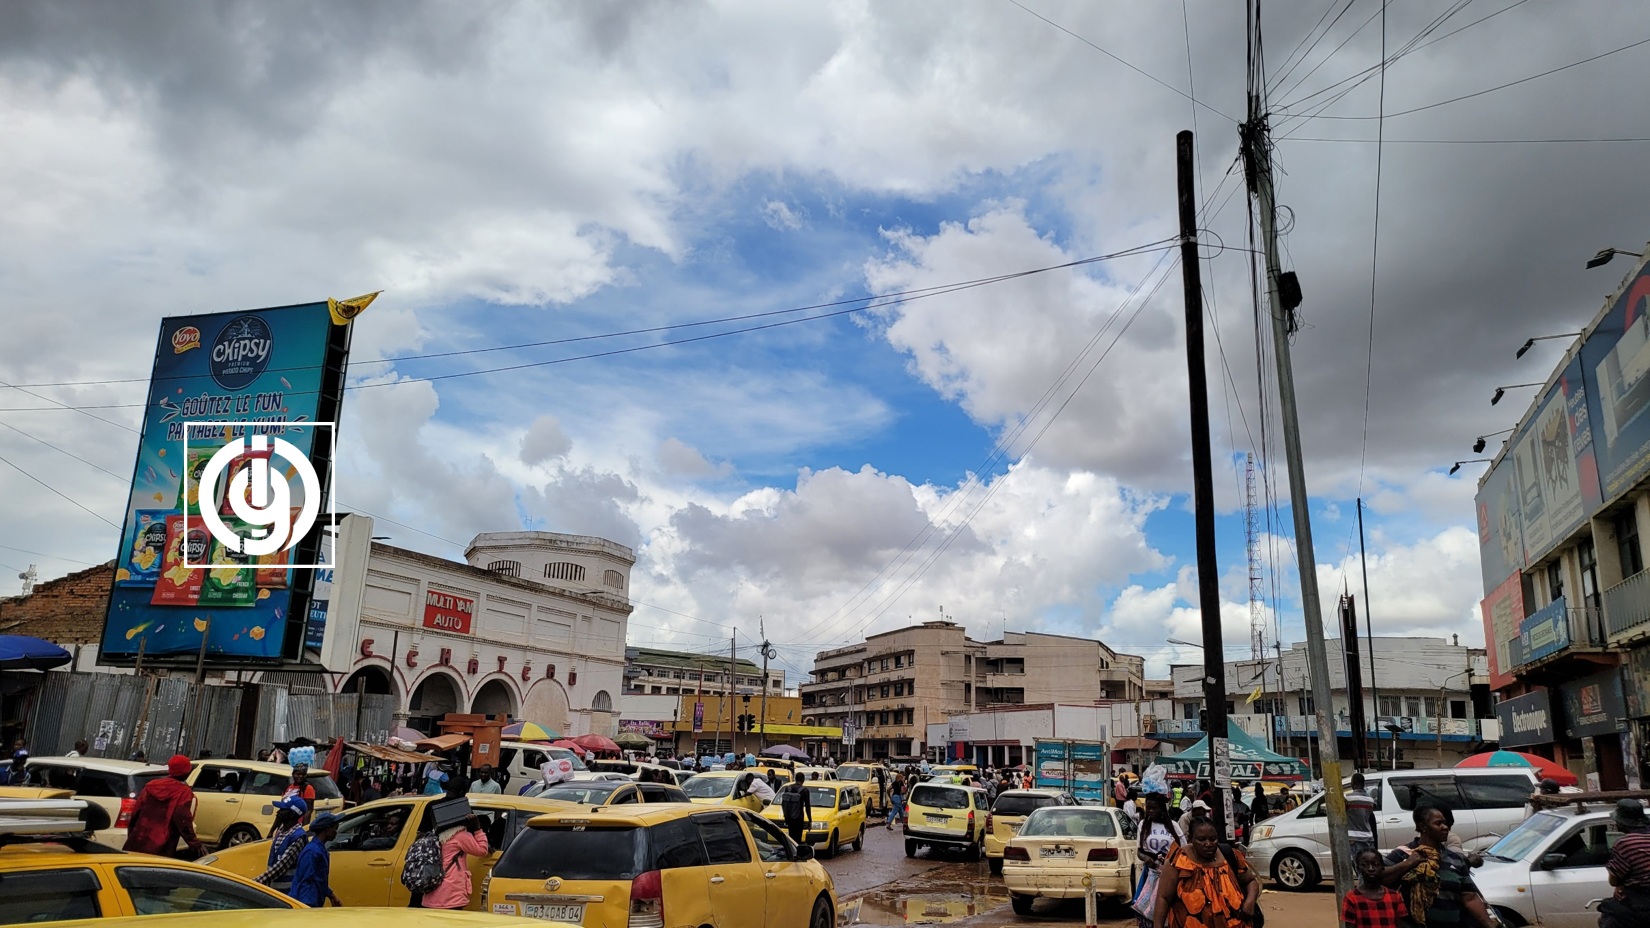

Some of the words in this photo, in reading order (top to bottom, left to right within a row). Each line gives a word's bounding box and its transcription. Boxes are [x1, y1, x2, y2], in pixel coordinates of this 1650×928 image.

[173, 330, 199, 345] Yoyo
[181, 392, 232, 417] GOÛTEZ
[235, 393, 251, 414] LE
[254, 391, 284, 413] FUN
[426, 593, 453, 610] MULTI
[456, 598, 475, 614] YAM
[433, 613, 463, 630] AUTO
[1201, 764, 1257, 777] TTAL
[1150, 838, 1170, 851] 02
[534, 906, 566, 919] 8340AB
[568, 907, 579, 919] 04
